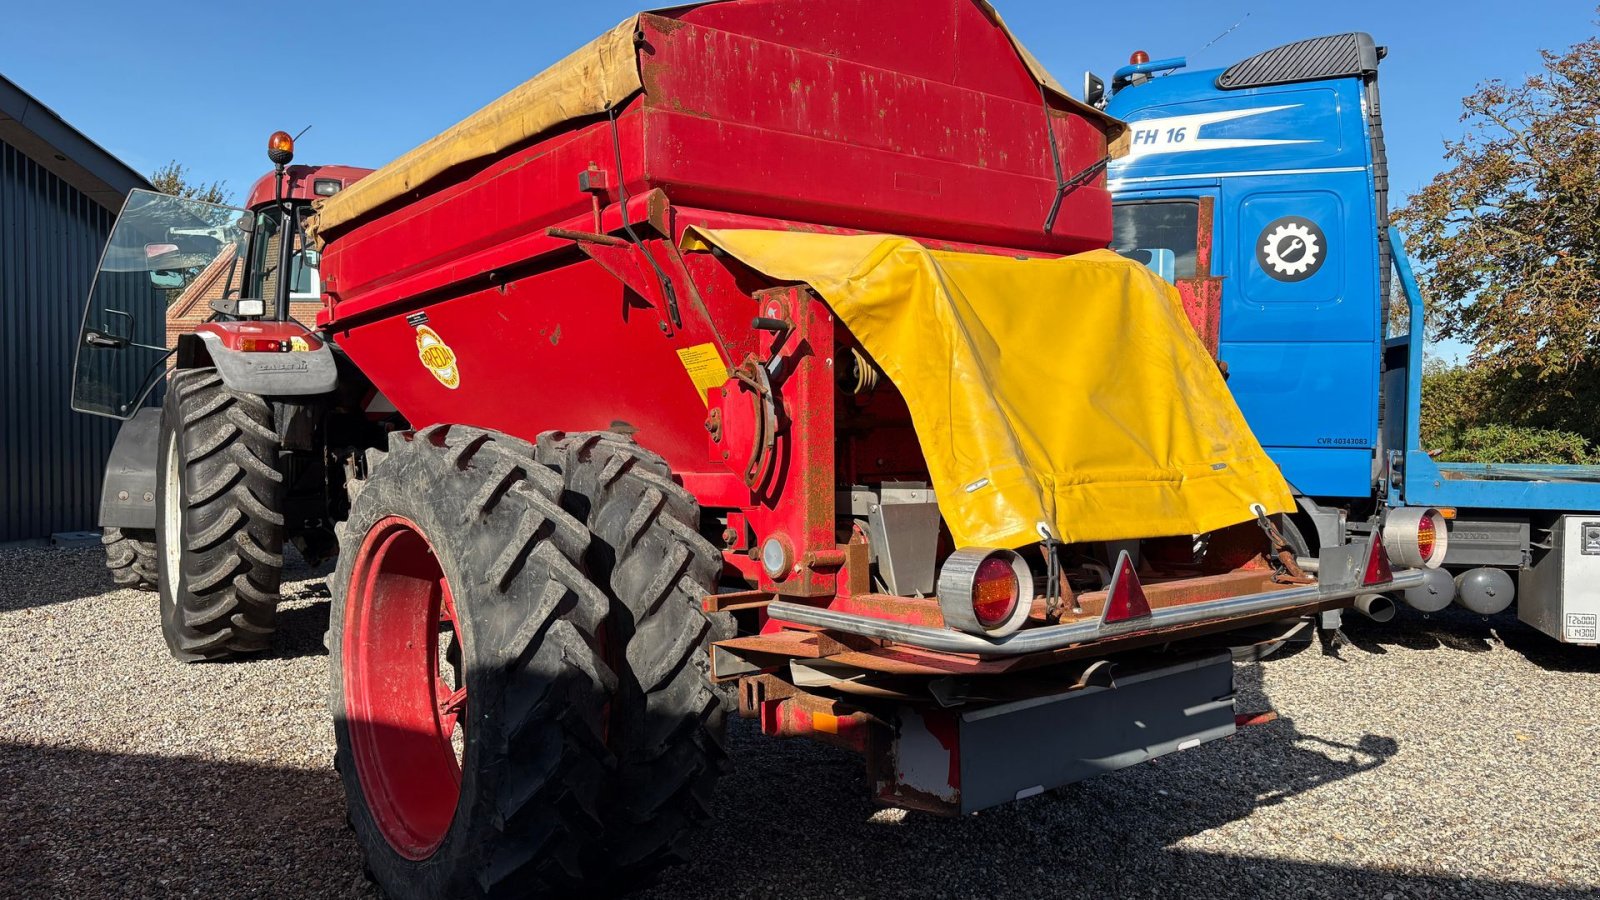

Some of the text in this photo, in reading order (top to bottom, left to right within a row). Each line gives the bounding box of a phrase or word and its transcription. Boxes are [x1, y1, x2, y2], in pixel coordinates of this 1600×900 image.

[1133, 127, 1187, 144] FH 16
[1574, 629, 1595, 637] 14300
